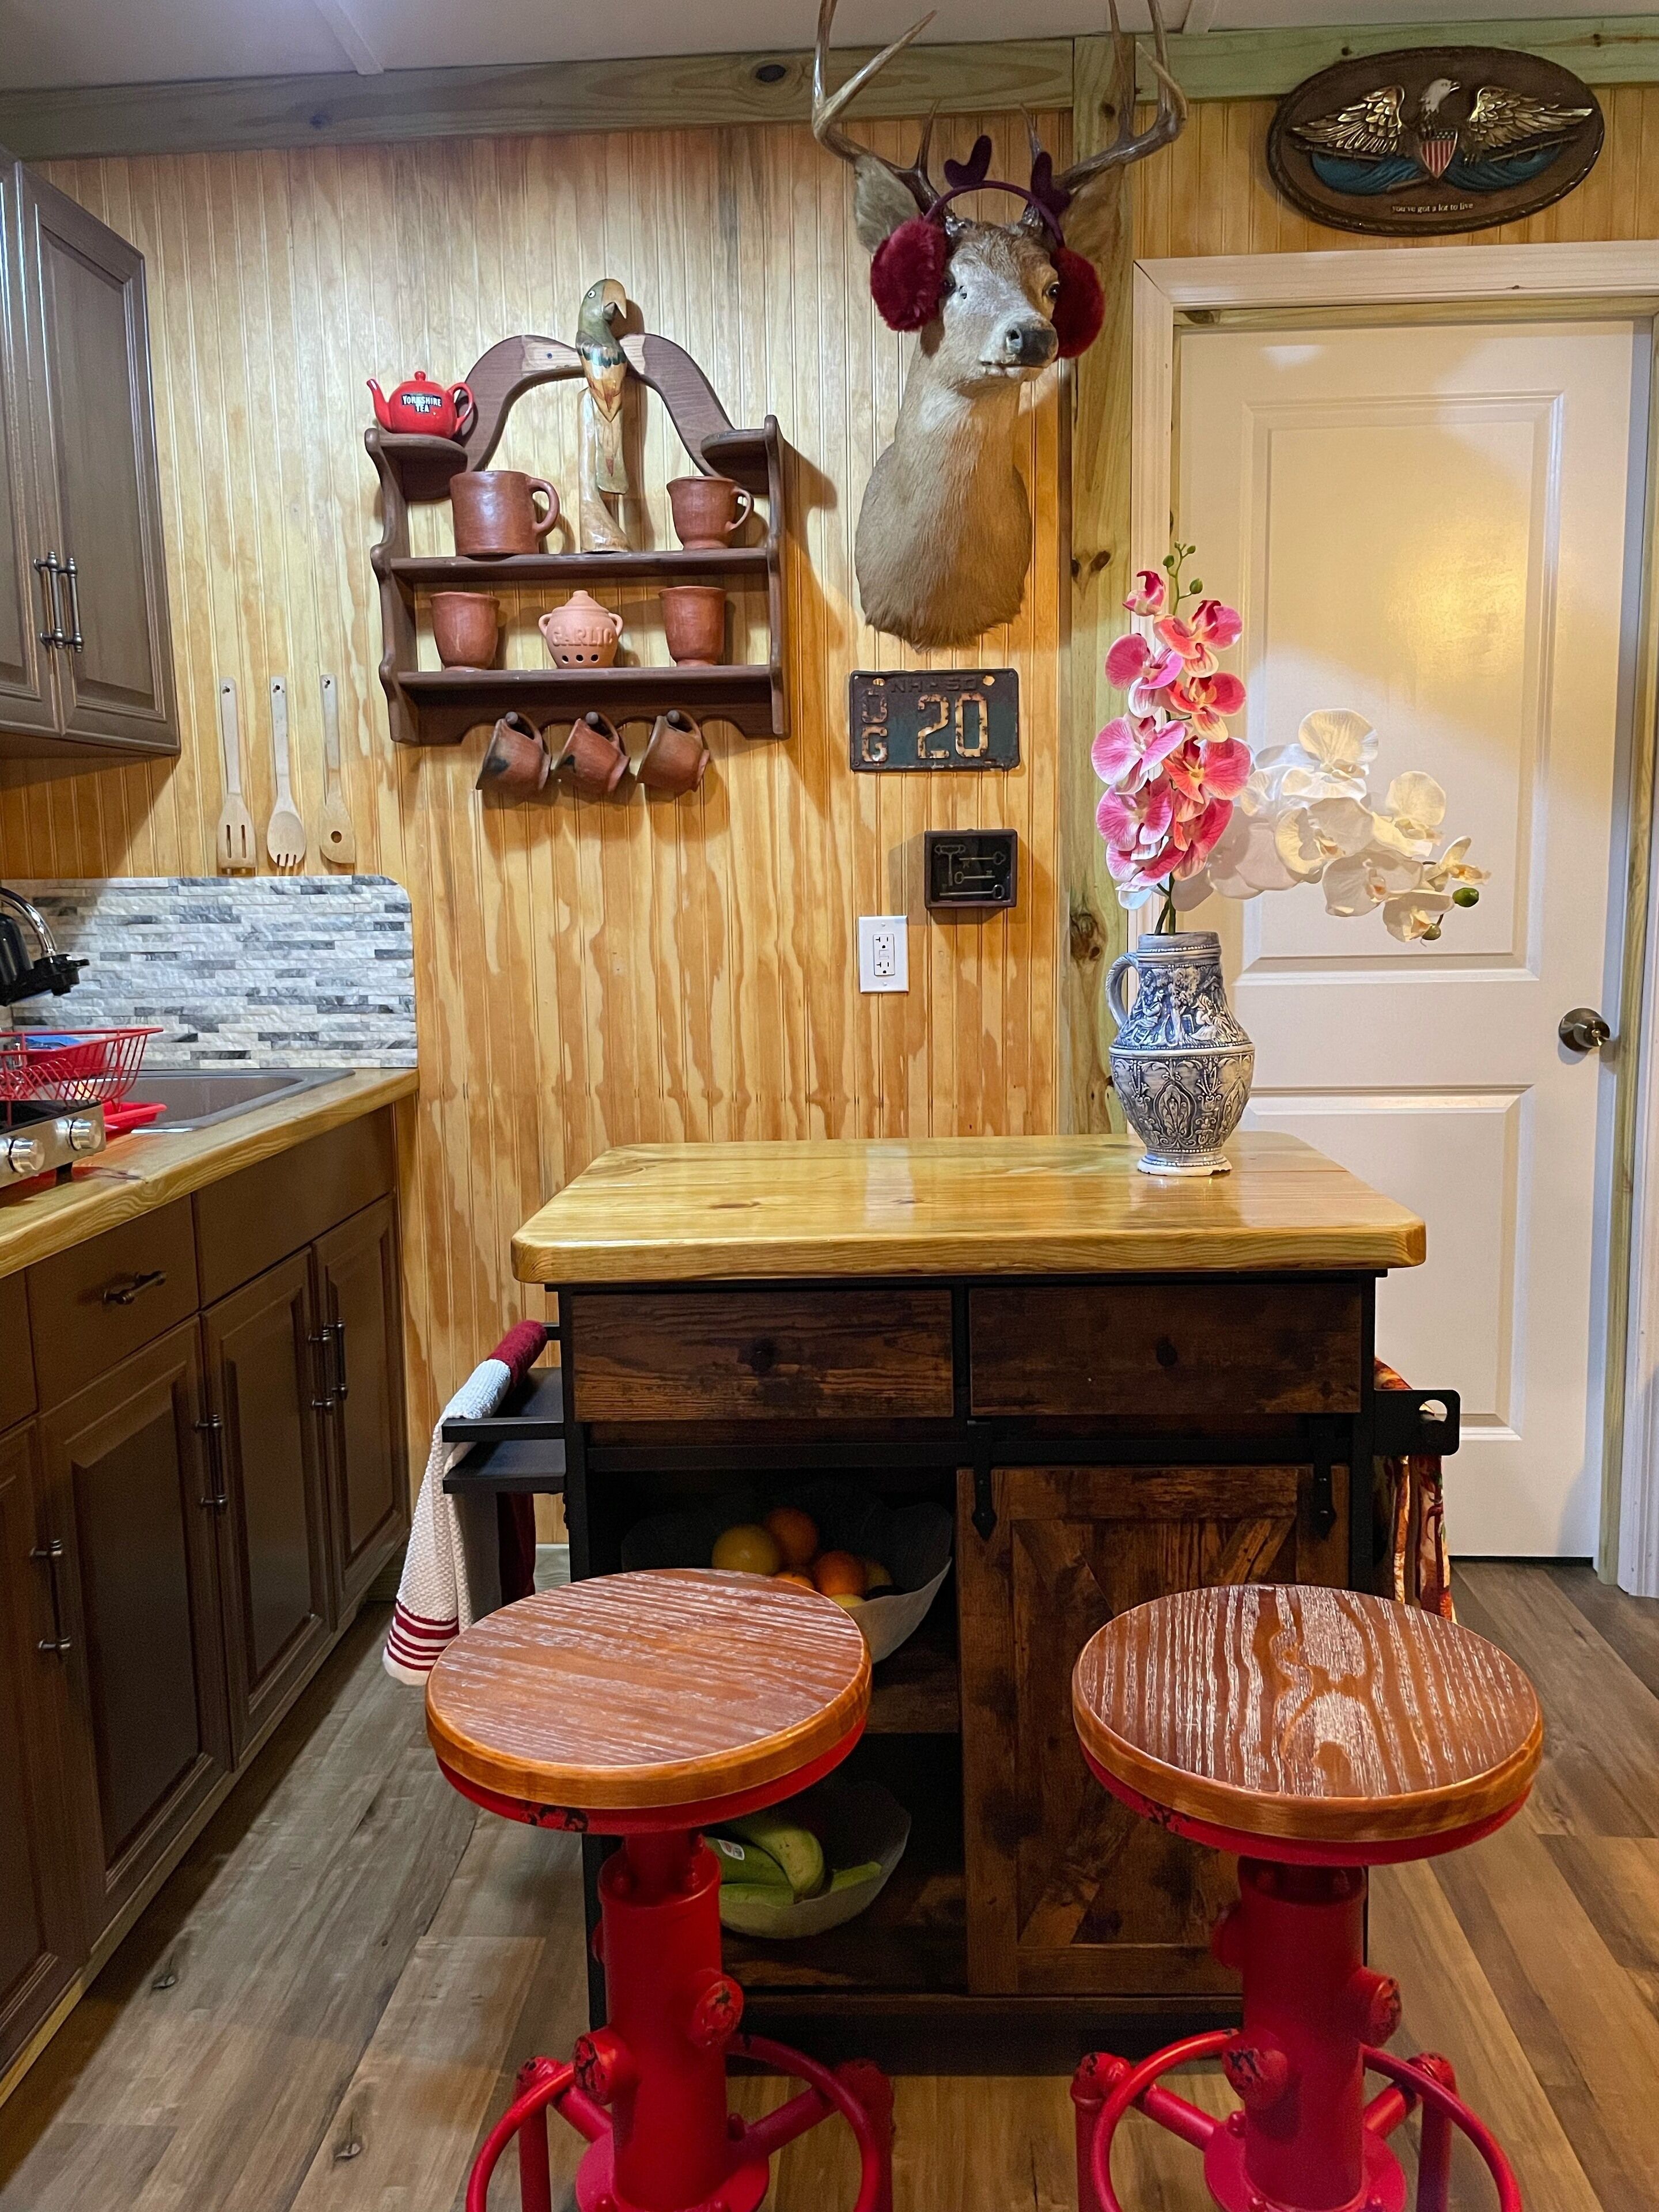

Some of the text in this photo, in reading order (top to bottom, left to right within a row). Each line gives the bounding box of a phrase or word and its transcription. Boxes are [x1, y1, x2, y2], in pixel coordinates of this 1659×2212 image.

[1417, 205, 1430, 214] got
[1438, 203, 1448, 211] lot
[1459, 202, 1474, 210] live
[402, 395, 442, 407] YORKSHIRE
[415, 403, 430, 412] TEA
[552, 626, 613, 646] GARLIC
[917, 692, 989, 759] 20
